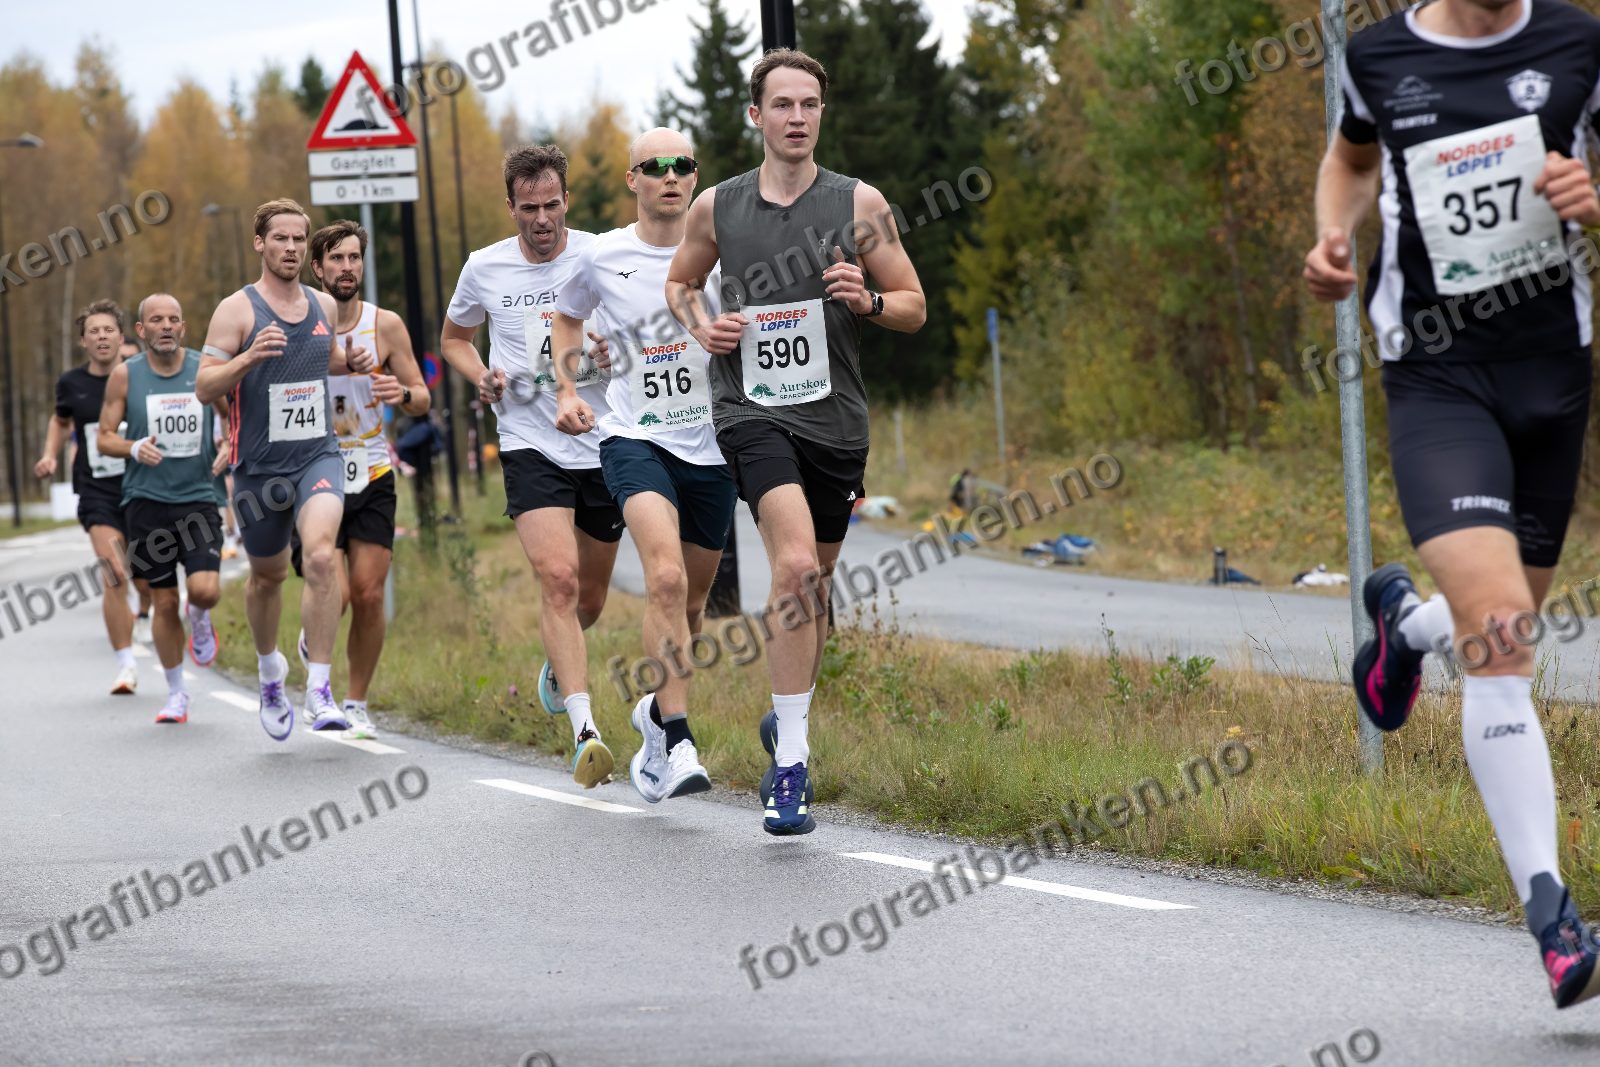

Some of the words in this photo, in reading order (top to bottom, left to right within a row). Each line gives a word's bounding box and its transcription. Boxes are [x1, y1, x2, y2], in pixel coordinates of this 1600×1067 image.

[1436, 134, 1515, 166] NORGES
[331, 157, 396, 172] Gangfelt
[1447, 151, 1504, 178] LØPET
[336, 185, 347, 199] 0
[1444, 177, 1522, 236] 357
[755, 308, 808, 323] NORGES
[760, 318, 801, 332] LØPET
[641, 341, 688, 356] NORGES
[758, 335, 810, 370] 590
[645, 352, 682, 365] LØPET
[643, 367, 692, 399] 516
[779, 378, 828, 393] Aurskog
[284, 386, 317, 396] NORGES
[282, 406, 316, 430] 744
[665, 404, 709, 420] Aurskog
[154, 414, 198, 434] 1008
